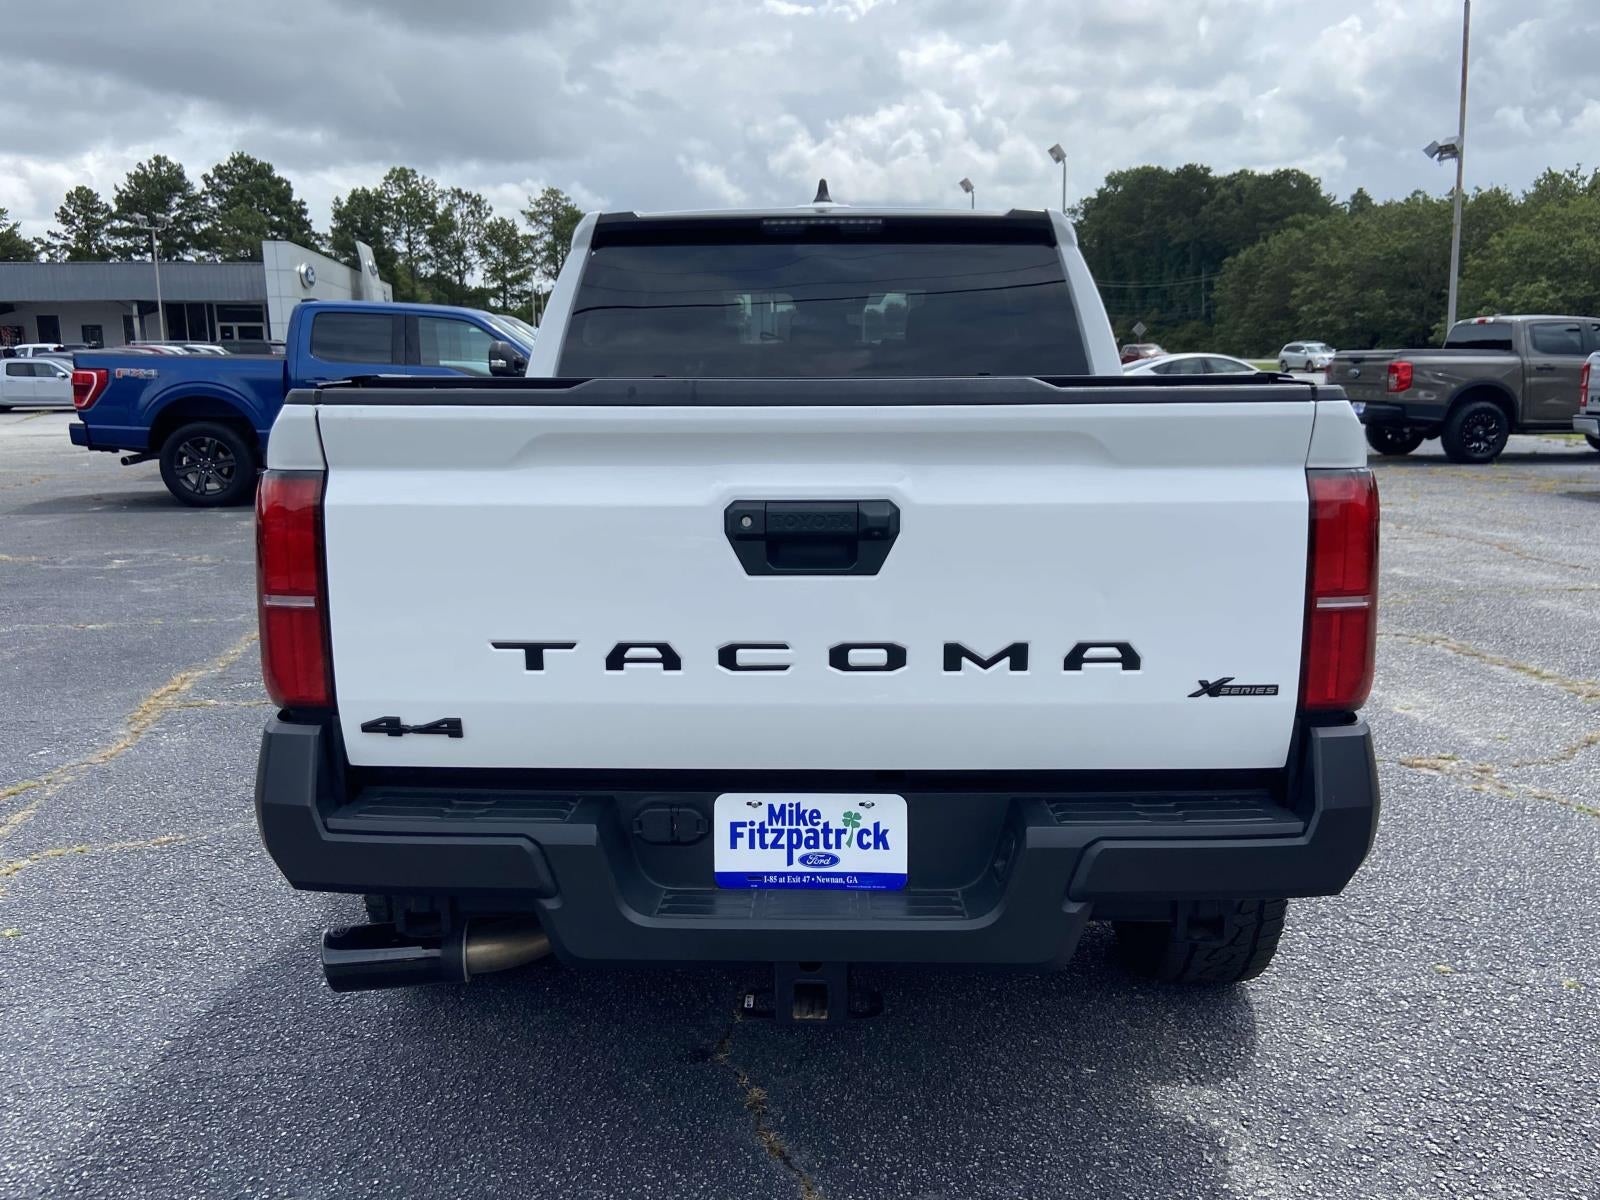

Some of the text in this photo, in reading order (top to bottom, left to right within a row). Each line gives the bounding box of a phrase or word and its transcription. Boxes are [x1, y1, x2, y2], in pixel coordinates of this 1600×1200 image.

[771, 514, 852, 529] TOYOTA
[489, 641, 1142, 672] TACOMA
[767, 801, 822, 826] Mike
[805, 853, 833, 866] Ford
[763, 875, 858, 885] I-85 at Exit 47 Newnan, GA
